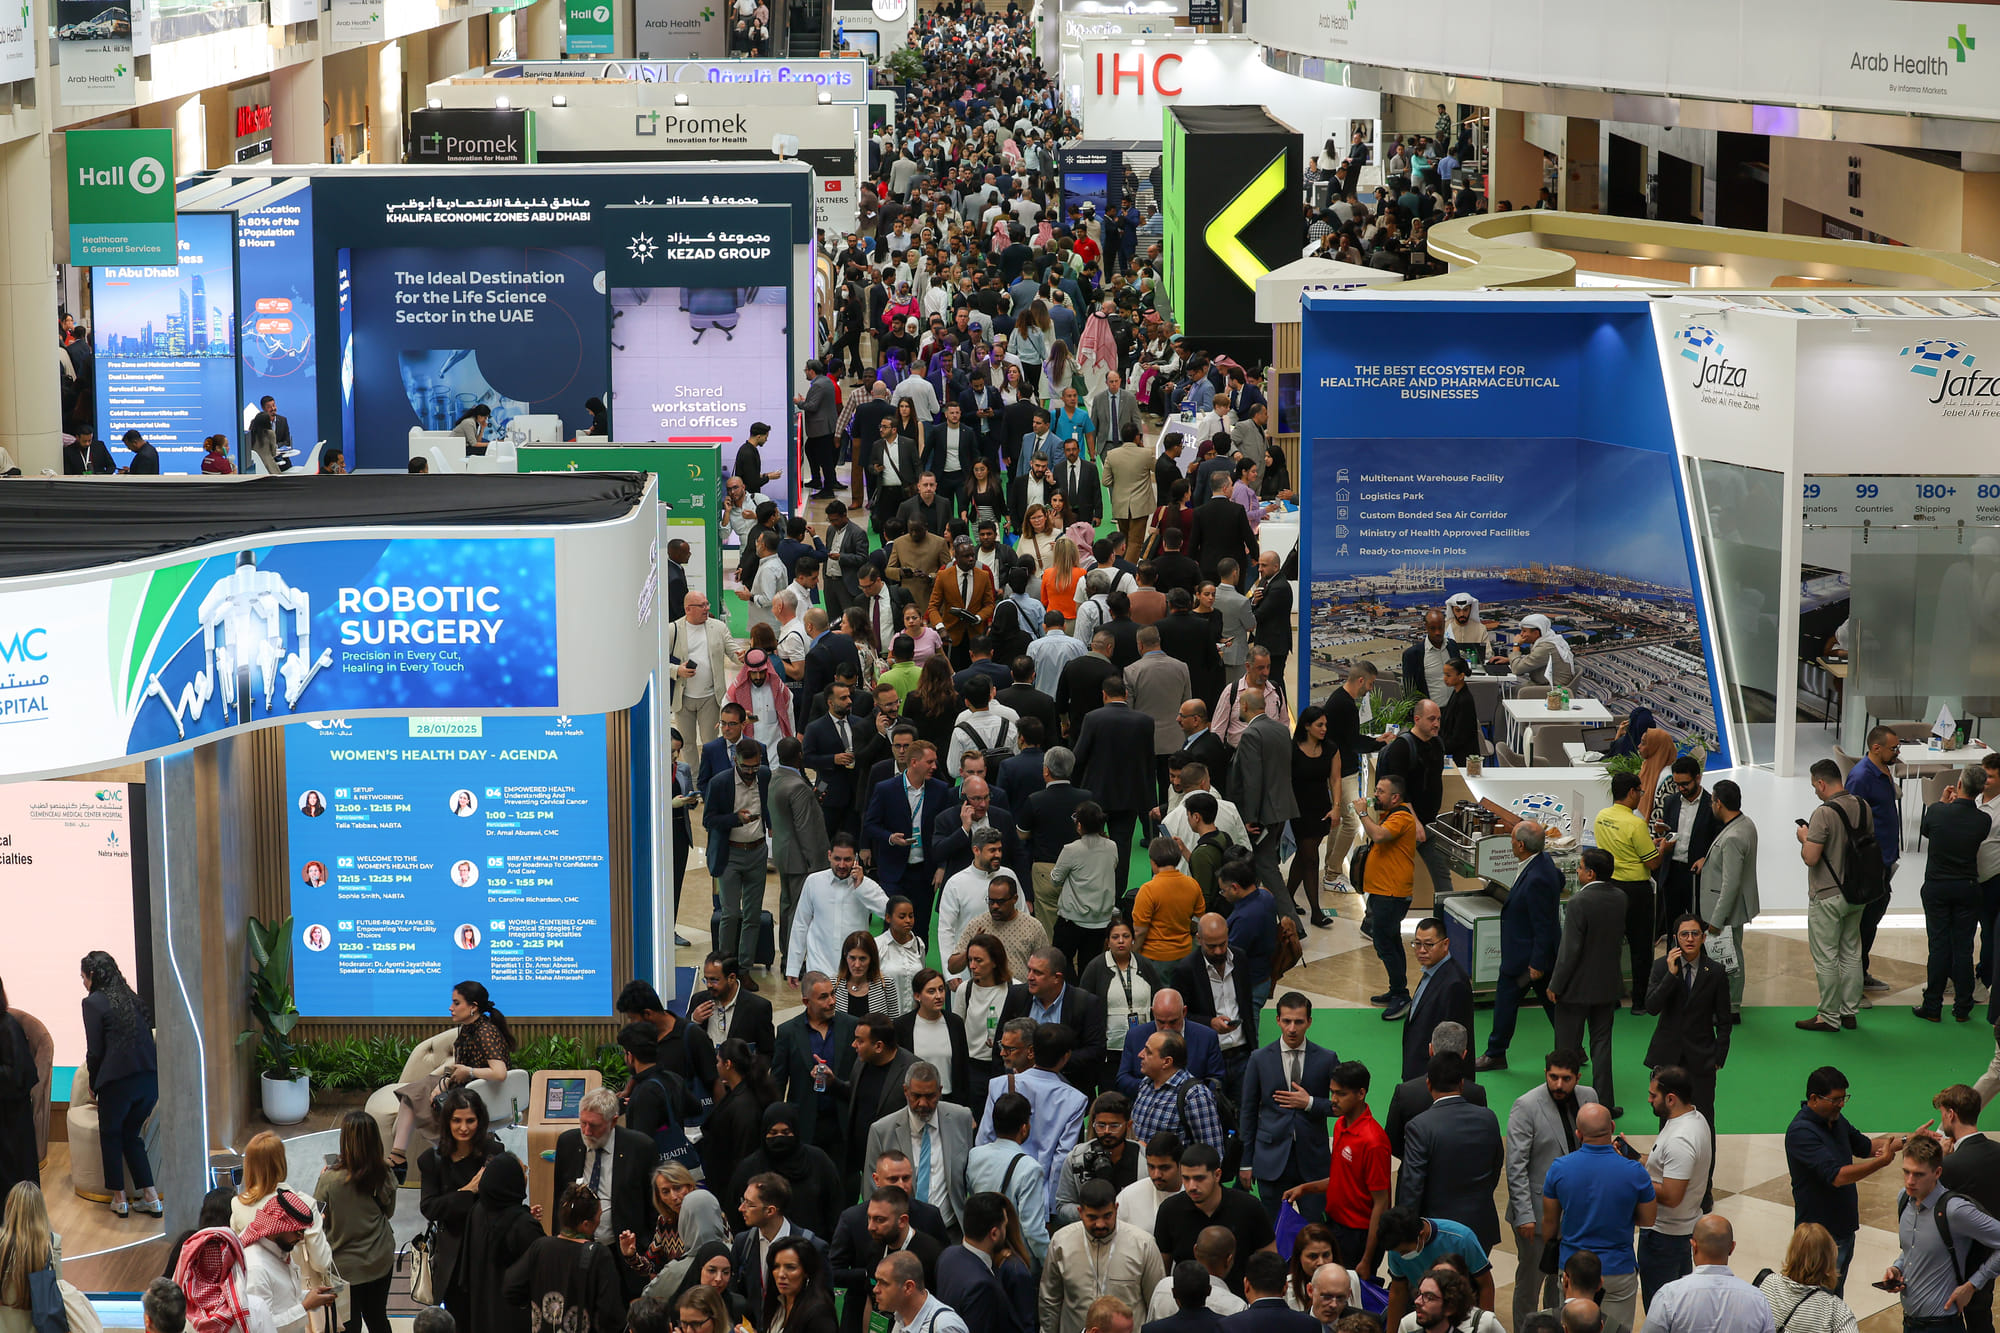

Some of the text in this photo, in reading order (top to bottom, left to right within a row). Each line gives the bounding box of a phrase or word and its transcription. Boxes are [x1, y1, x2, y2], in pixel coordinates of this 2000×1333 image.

[571, 10, 591, 19] Hall
[645, 20, 701, 28] Arab Health
[1850, 52, 1947, 76] Arab Health
[67, 75, 115, 83] Arab Health
[554, 70, 585, 78] Mankind
[1097, 53, 1183, 96] IHC
[666, 113, 747, 133] Promek
[447, 135, 518, 153] Promek
[79, 163, 156, 188] Hall 6
[504, 198, 548, 208] خليفة
[550, 197, 590, 208] مناطق
[260, 205, 301, 214] Location
[248, 217, 299, 226] 80% of the
[386, 212, 590, 223] KHALIFA ECONOMIC ZONES ABU DHABI
[244, 228, 295, 237] Population
[719, 232, 771, 243] مجموعة
[82, 235, 128, 244] Healthcare
[247, 239, 275, 248] Hours
[90, 245, 123, 253] General
[125, 245, 161, 253] Services
[668, 249, 771, 260] KEZAD GROUP
[105, 267, 179, 278] In Abu Dhabi
[395, 270, 565, 285] The Ideal Destination
[395, 290, 547, 304] for the Life Science
[396, 309, 534, 323] Sector in the UAE
[1355, 365, 1525, 375] THE BEST ECOSYSTEM FOR
[1693, 356, 1747, 388] Jafza
[1320, 377, 1559, 387] HEALTHCARE AND PHARMACEUTICAL
[674, 385, 723, 398] Shared
[1401, 389, 1479, 399] BUSINESSES
[652, 401, 746, 412] workstations
[661, 415, 738, 428] and offices
[1360, 473, 1504, 483] Multitenant Warehouse Facility
[1856, 484, 1879, 498] 99
[1915, 484, 1957, 498] 180+
[1360, 492, 1424, 502] Logistics Park
[1855, 505, 1951, 514] Countries Shipping
[1360, 511, 1508, 519] Custom Bonded Sea Air Corridor
[1360, 528, 1530, 538] Ministry of Health Approved Facilities
[1360, 547, 1467, 556] Ready-to-move-in Plots
[338, 586, 501, 613] ROBOTIC
[340, 619, 504, 645] SURGERY
[342, 650, 461, 661] Precision in Every Cut,
[342, 662, 465, 674] Healing in Every Touch
[417, 725, 477, 734] 28/01/2025
[330, 750, 558, 761] WOMEN'S HEALTH DAY AGENDA
[103, 789, 122, 801] CMC
[336, 789, 347, 798] 01
[486, 789, 501, 797] 04
[335, 804, 411, 812] 12:00 12:15 PM
[485, 812, 554, 820] 1:00 1:25 PM
[338, 858, 353, 867] 02
[488, 858, 503, 867] 05
[337, 875, 412, 883] 12:15 12:25 PM
[488, 879, 553, 887] 1:30 1:55 PM
[339, 922, 352, 930] 03
[490, 921, 505, 929] 06
[339, 943, 415, 951] 12:30 12:55 PM
[490, 940, 564, 948] 2:00 2:25 PM
